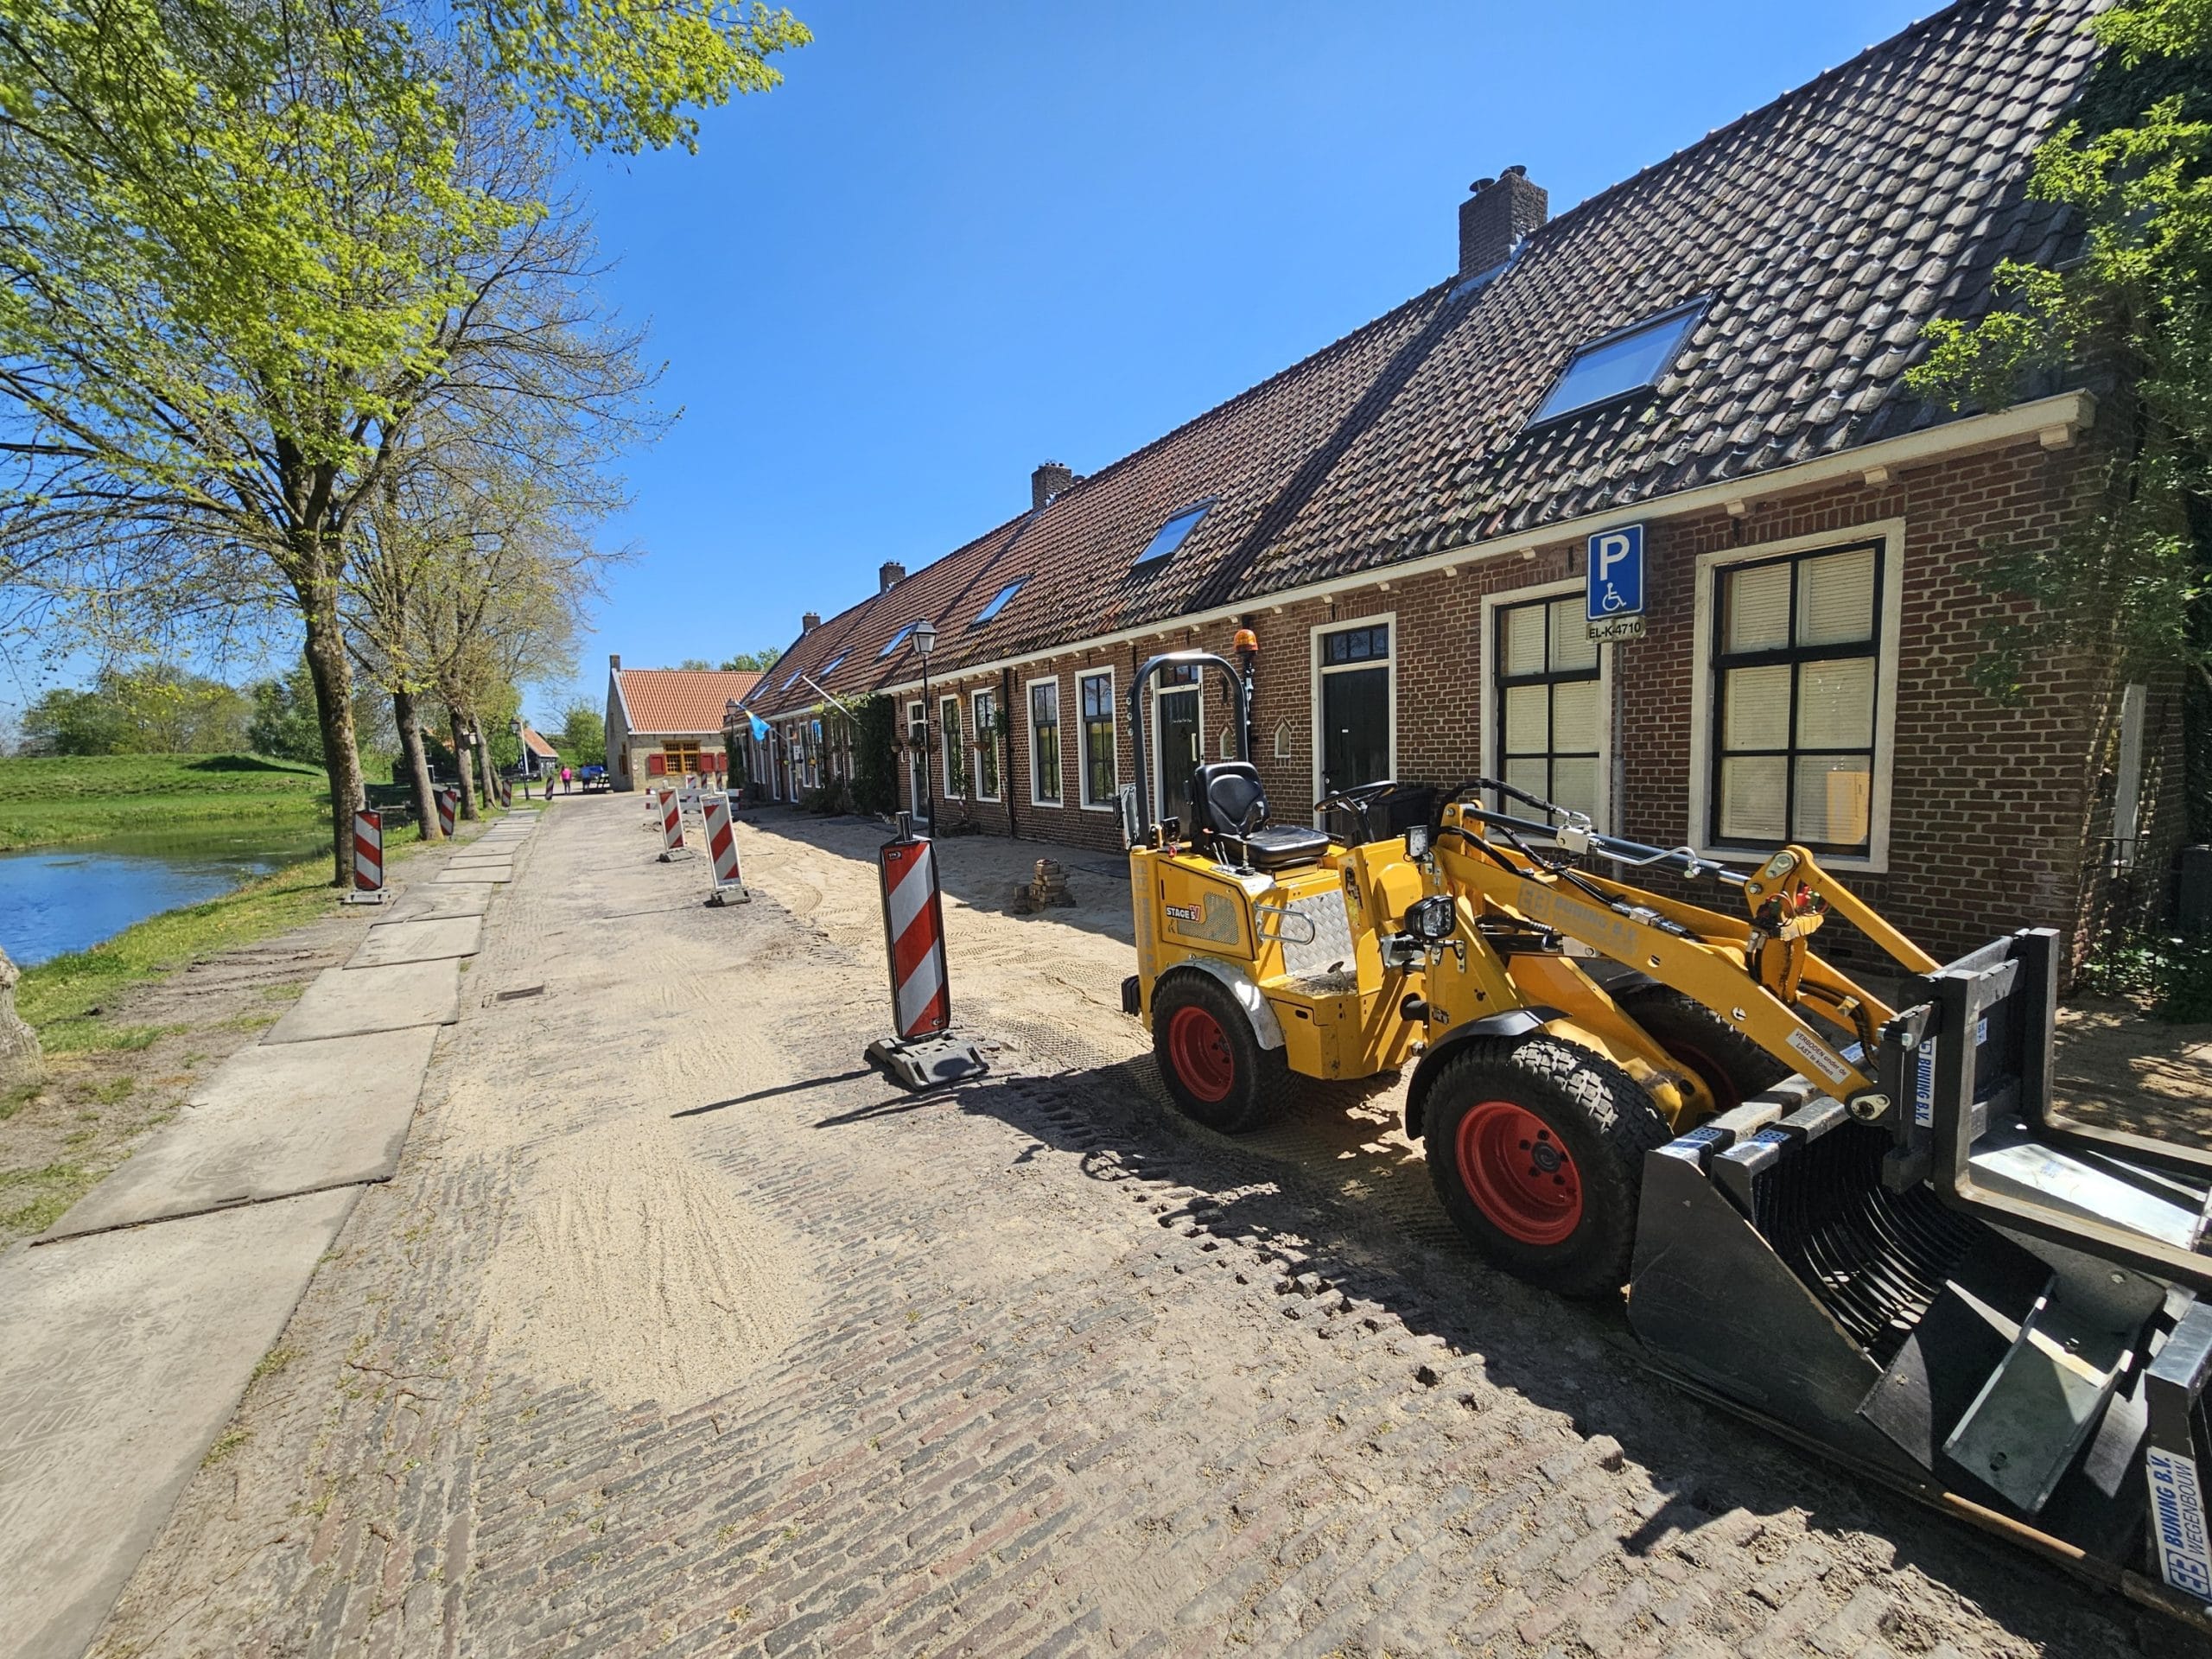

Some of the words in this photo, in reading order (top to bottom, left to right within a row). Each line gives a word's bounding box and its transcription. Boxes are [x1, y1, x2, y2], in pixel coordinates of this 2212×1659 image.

[1600, 534, 1630, 582] P
[1589, 622, 1641, 639] EL-K-4710
[1166, 907, 1190, 918] STAGE
[1796, 1031, 1825, 1057] VERBODEN
[1796, 1043, 1812, 1056] LAST
[1916, 1058, 1931, 1099] BUNING
[2151, 1454, 2174, 1484] B.V.
[2156, 1485, 2184, 1549] BUNING
[2174, 1460, 2206, 1555] WEGENBOUW
